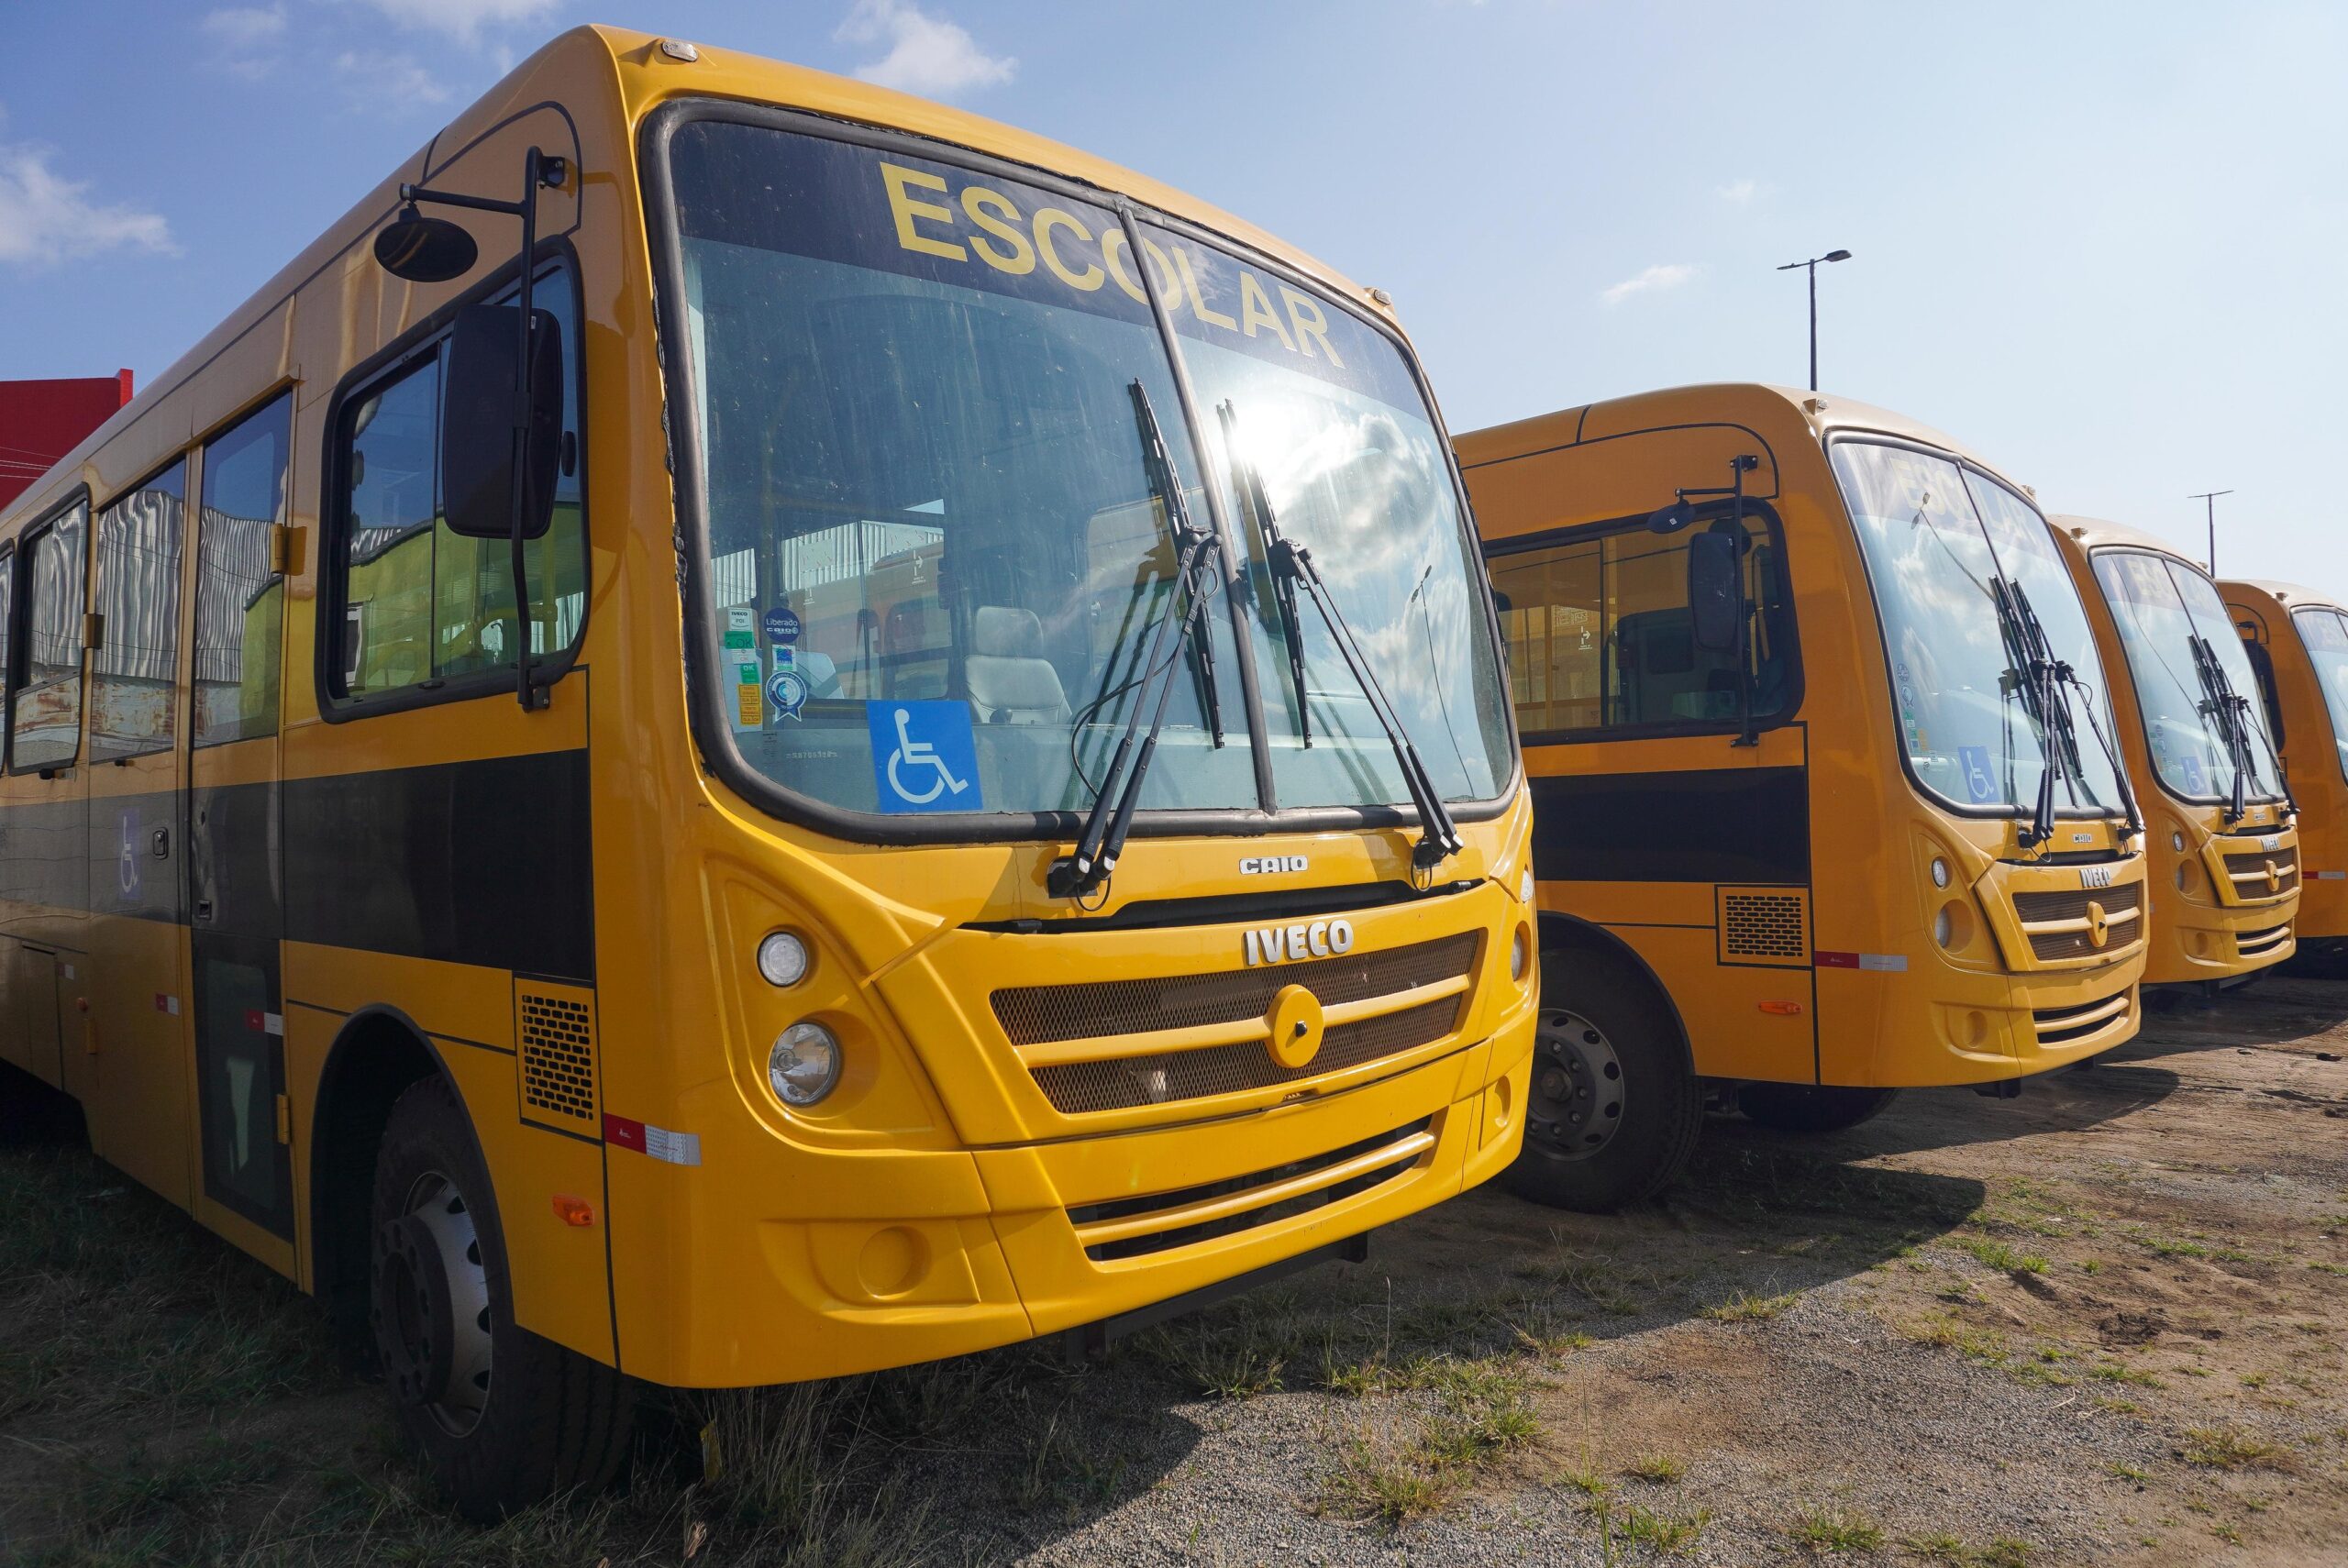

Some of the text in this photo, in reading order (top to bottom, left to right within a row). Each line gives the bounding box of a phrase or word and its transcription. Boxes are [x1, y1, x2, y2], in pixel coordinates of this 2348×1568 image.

[879, 161, 1346, 369] ESCOLAR
[766, 617, 798, 626] Liberado
[1239, 856, 1309, 875] CAIO
[2079, 867, 2111, 888] IVECO
[1244, 919, 1354, 966] IVECO
